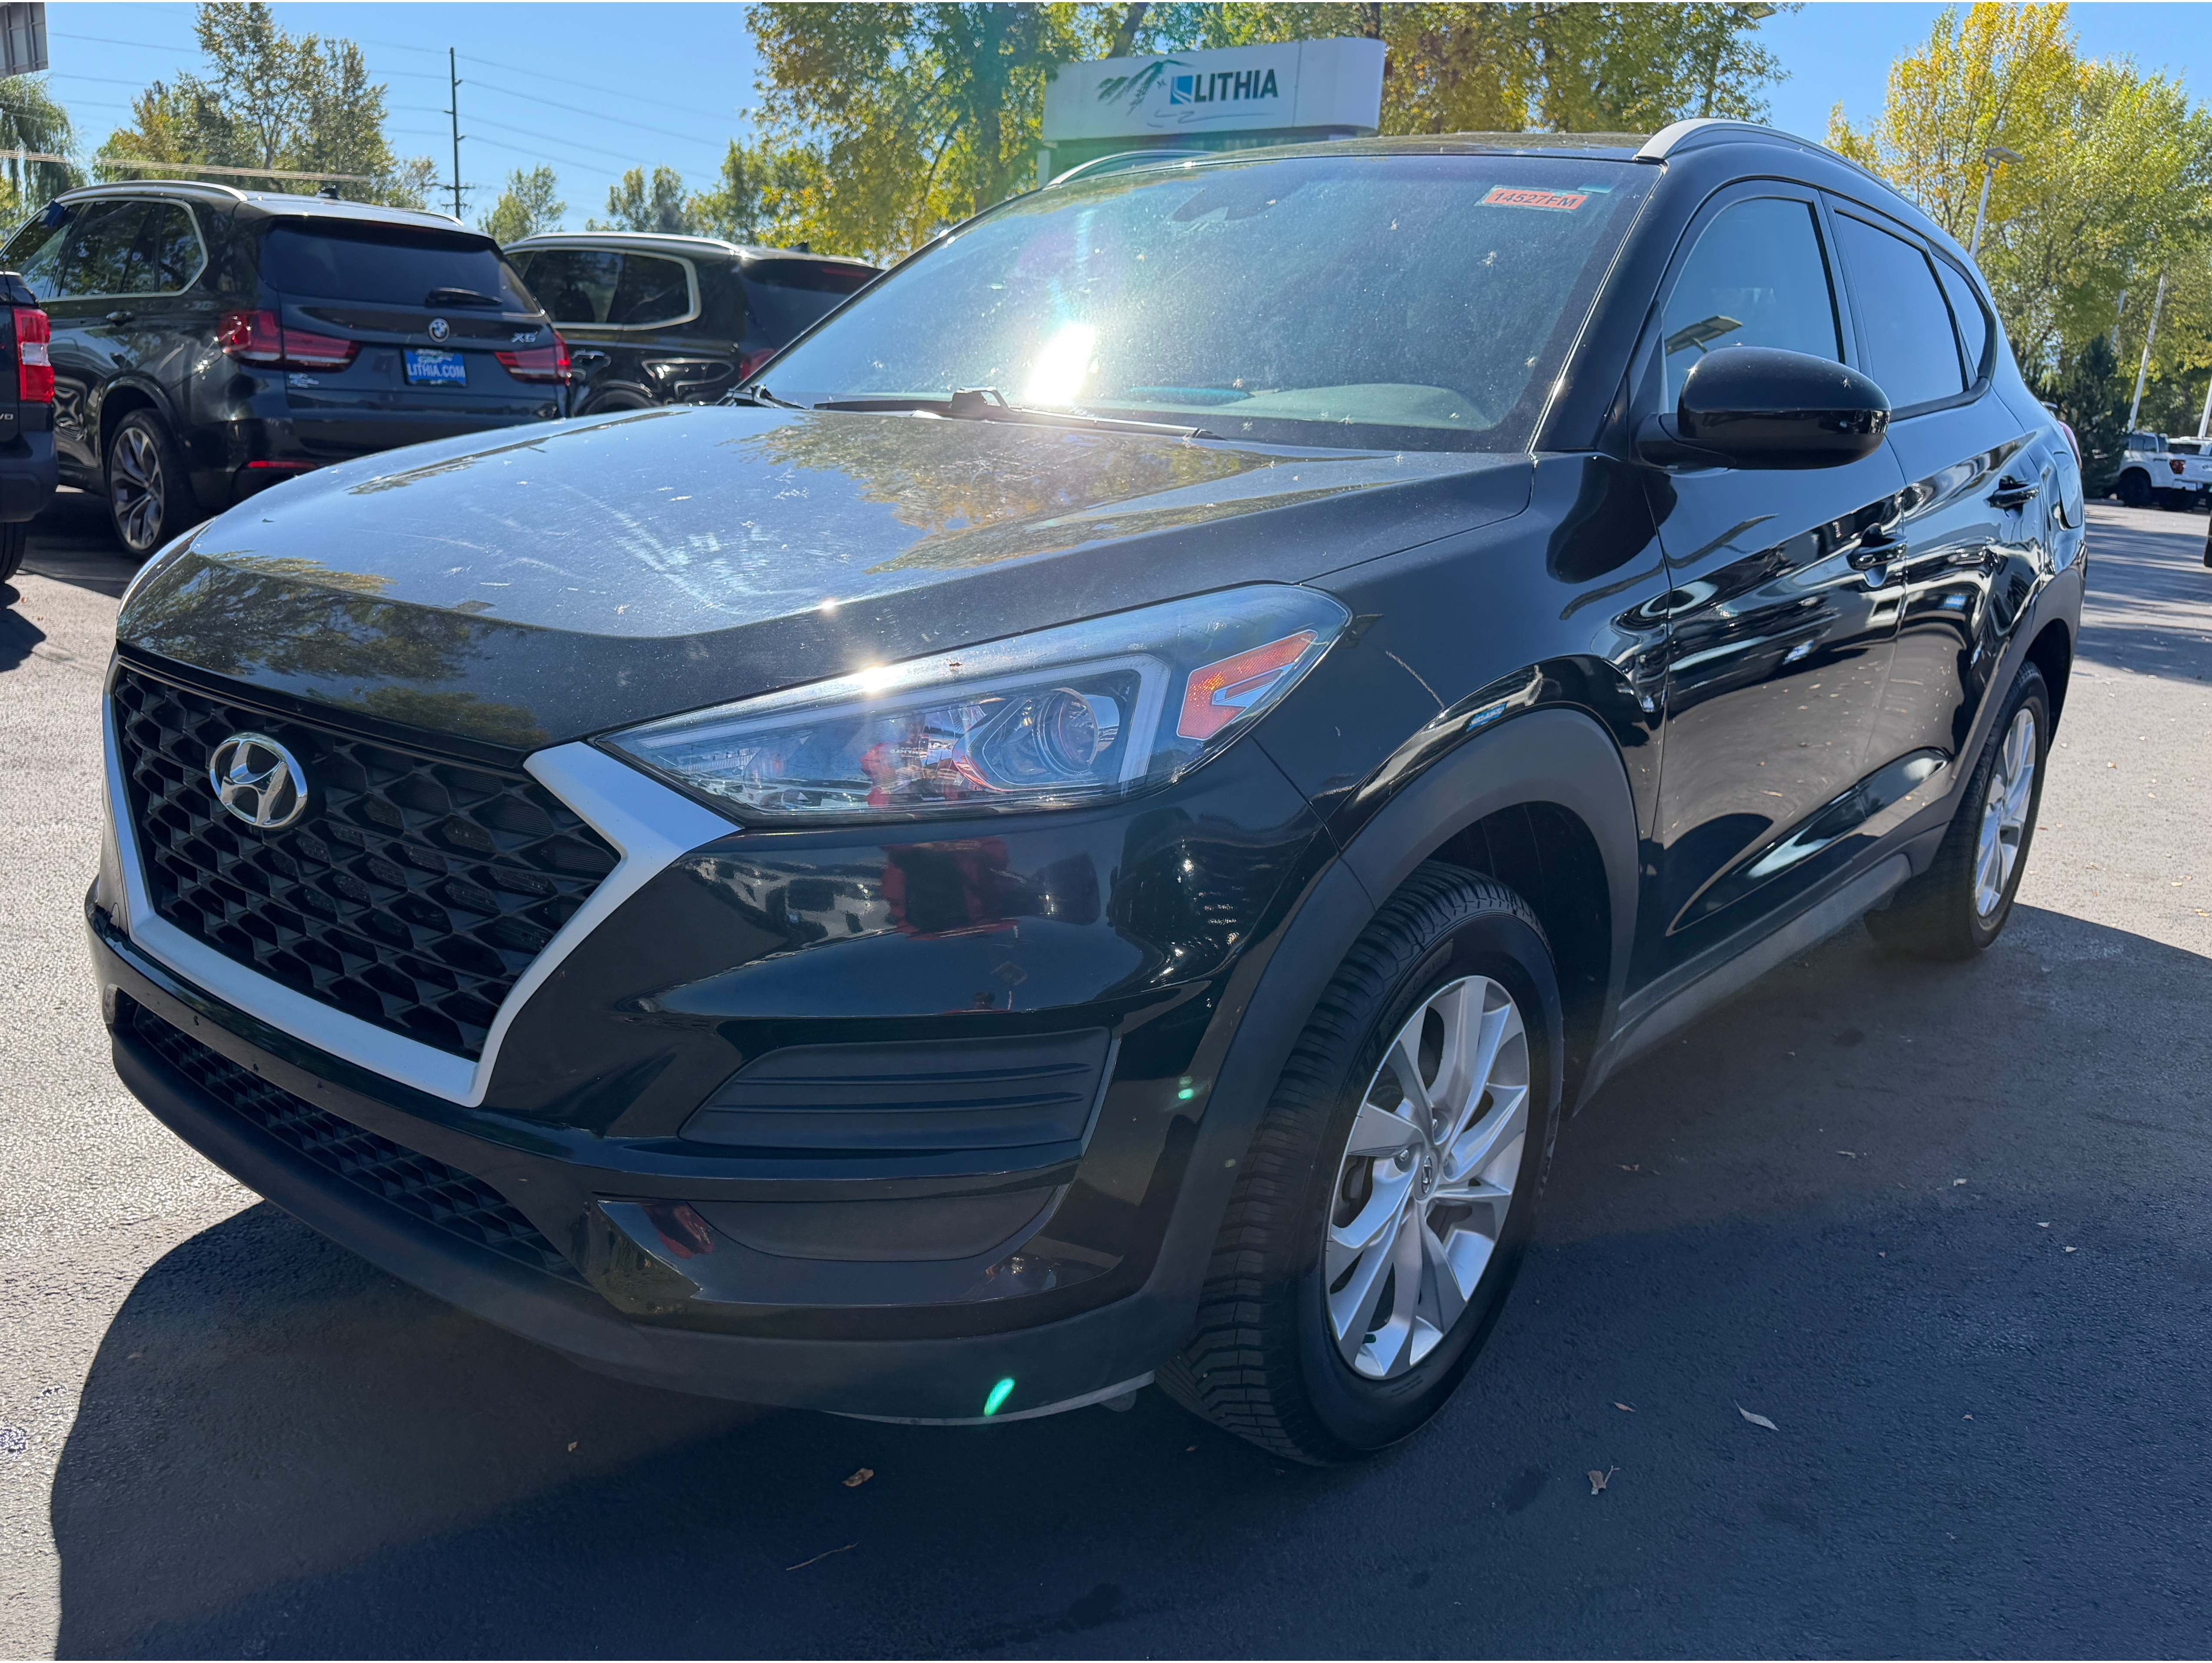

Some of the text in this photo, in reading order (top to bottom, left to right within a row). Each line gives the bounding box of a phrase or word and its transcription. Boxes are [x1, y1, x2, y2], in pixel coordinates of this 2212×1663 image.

[1194, 69, 1279, 103] LITHIA
[1494, 193, 1578, 207] 14527FM
[406, 363, 466, 378] LITHIA.COM
